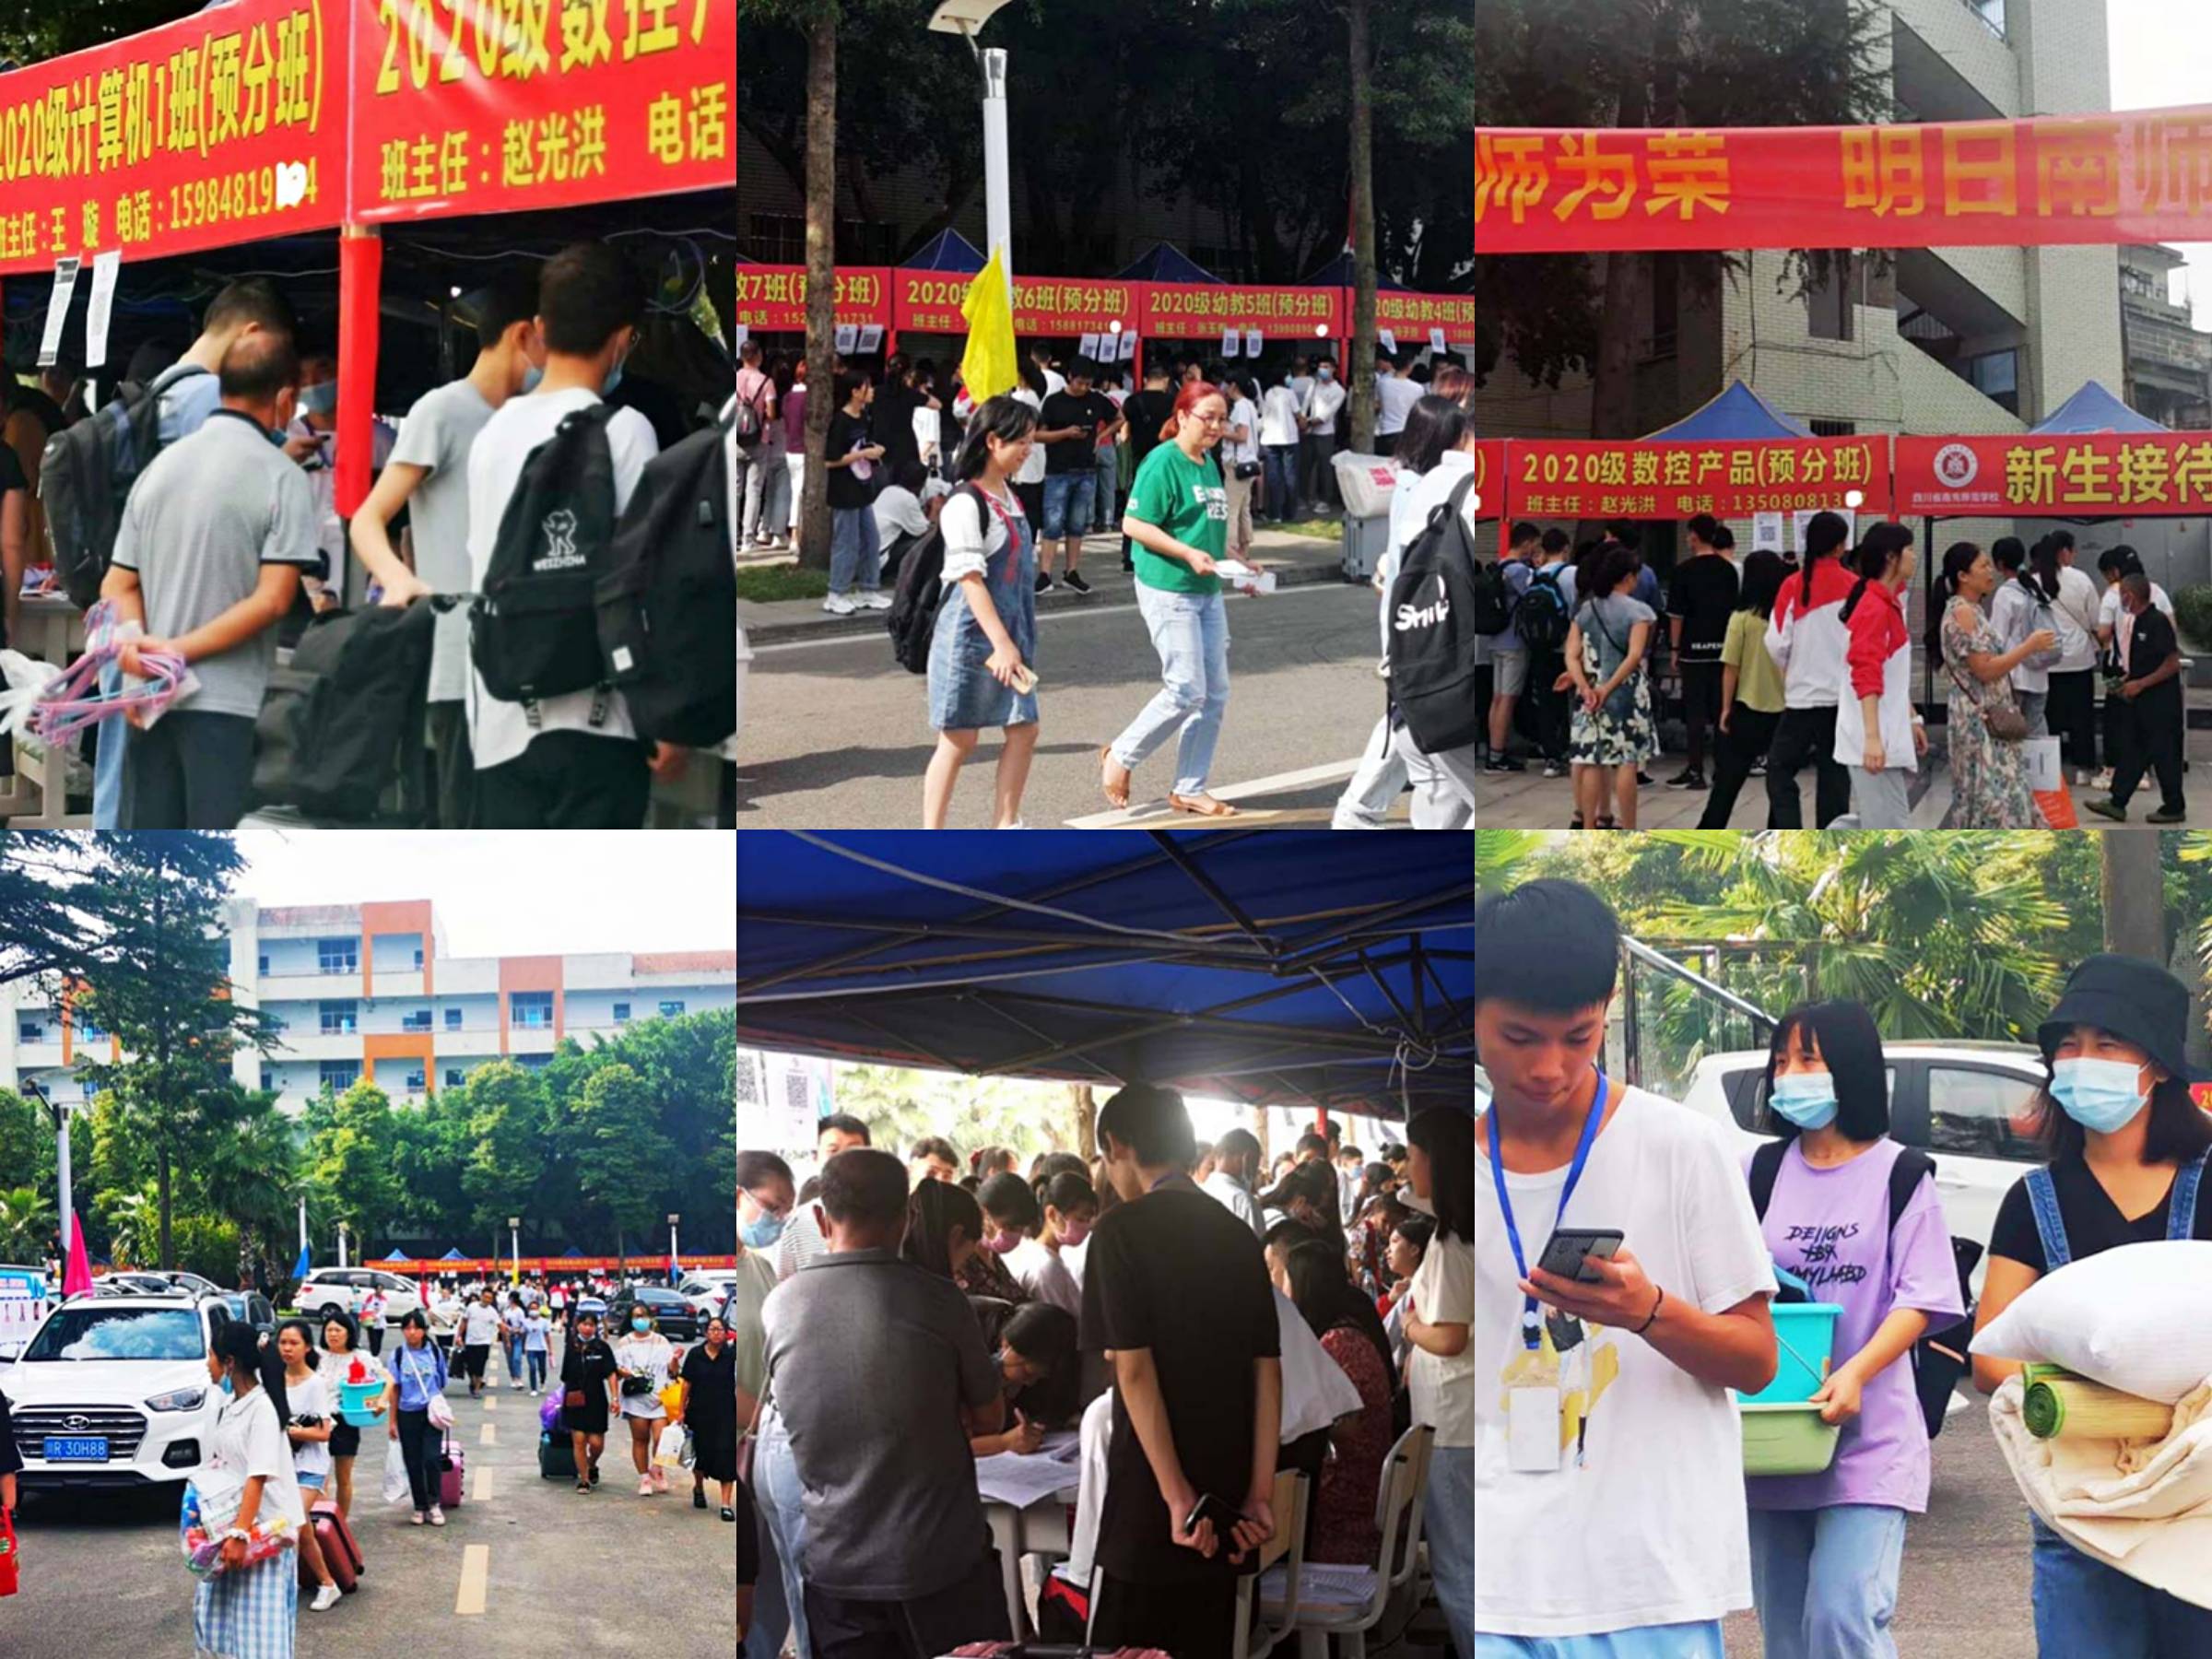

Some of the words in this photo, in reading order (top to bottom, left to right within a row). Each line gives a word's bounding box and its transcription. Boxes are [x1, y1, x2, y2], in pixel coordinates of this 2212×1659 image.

[0, 0, 323, 182] 020级计算机1班(预分班)
[648, 82, 727, 164] 电话
[116, 156, 318, 242] 电话：159848194
[1475, 129, 1731, 224] 师为荣
[1150, 291, 1333, 319] 2020级幼教5班(预分班)
[1523, 442, 1873, 488] 2020级数控产品(预分班)
[2006, 441, 2212, 506] 新生接待
